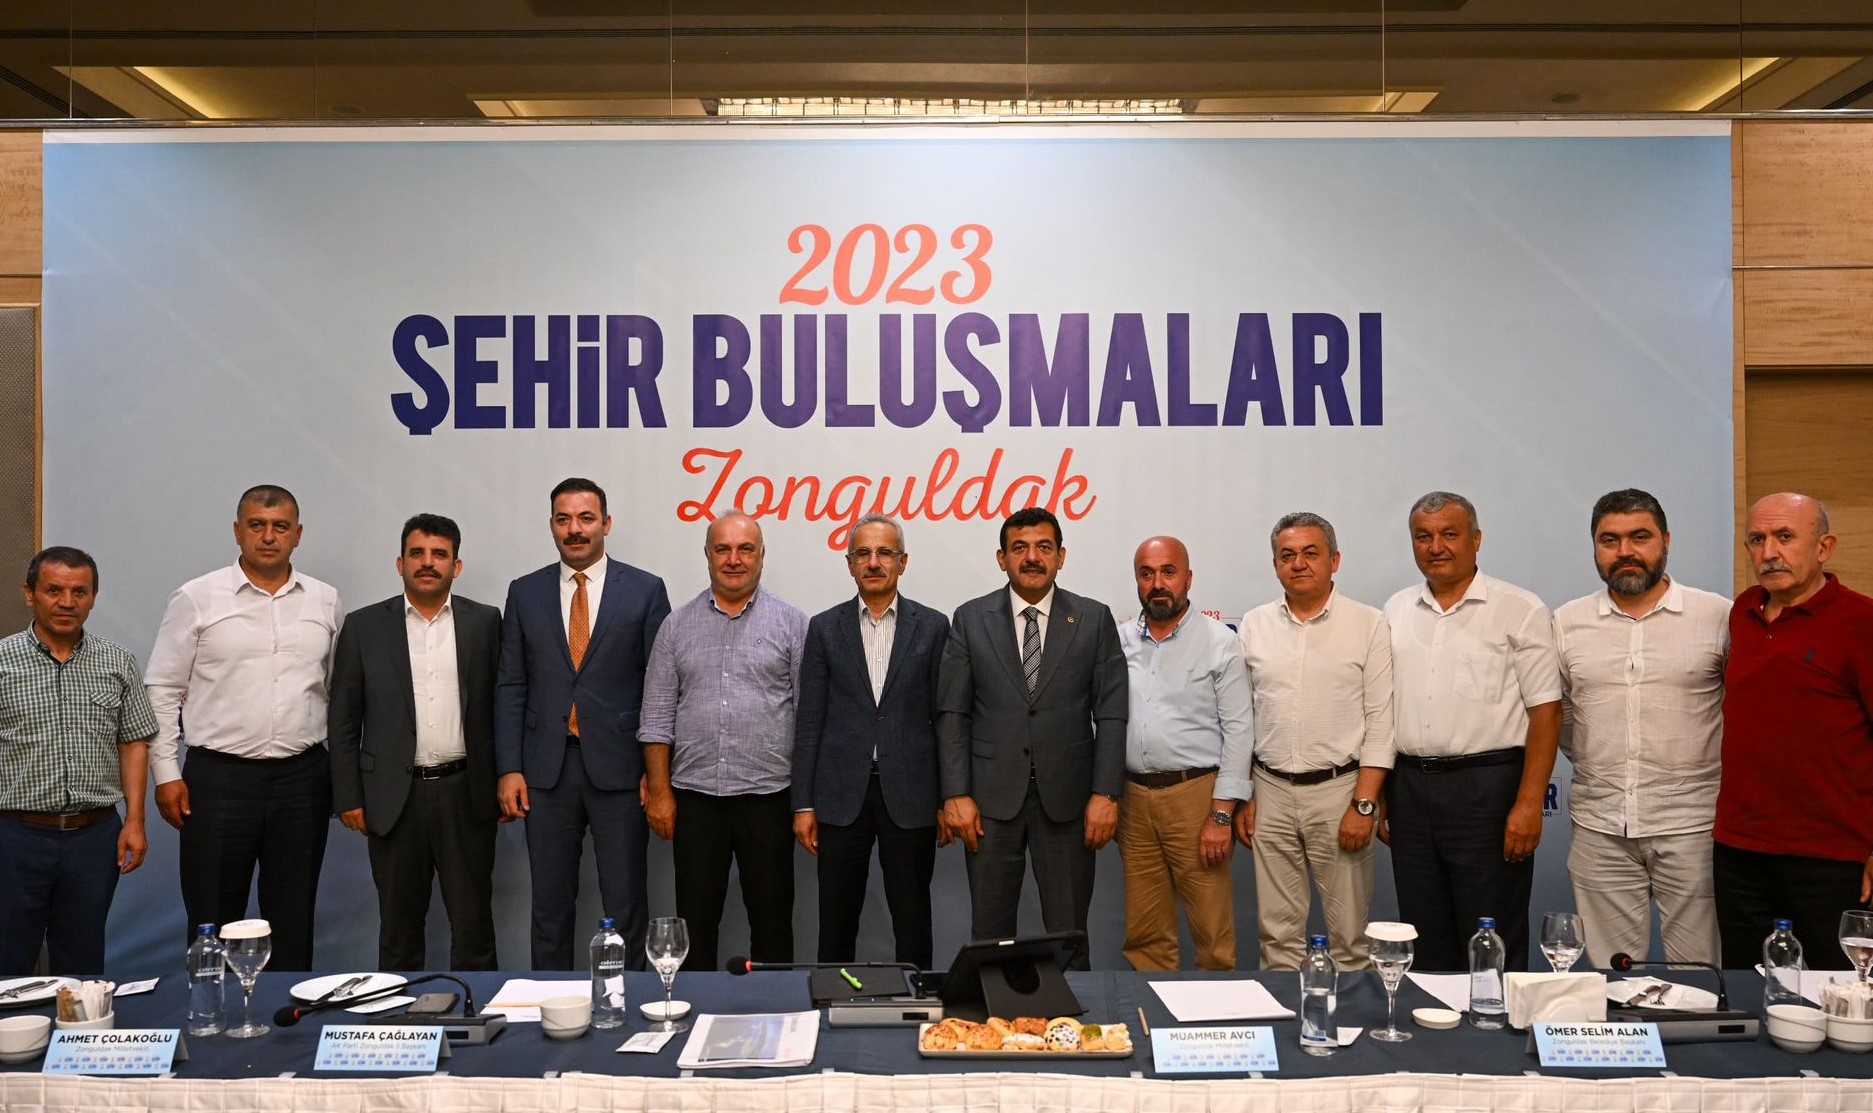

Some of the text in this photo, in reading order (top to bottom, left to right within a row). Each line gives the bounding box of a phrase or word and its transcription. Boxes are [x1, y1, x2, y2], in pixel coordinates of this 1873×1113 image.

[778, 223, 993, 305] 2023
[390, 312, 1384, 435] ŞEHİR BULUŞMALARI
[676, 447, 1097, 551] Zonguldak
[324, 1029, 438, 1041] MUSTAFA ÇAĞLAYAN
[1170, 1031, 1256, 1041] MUAMMER AVCI
[1545, 1025, 1649, 1036] ÖMER SELİM ALAN
[58, 1032, 173, 1044] AHMET ÇOLAKOĞLU
[1552, 1038, 1588, 1046] Zonguldak
[75, 1045, 112, 1053] Zonguldak
